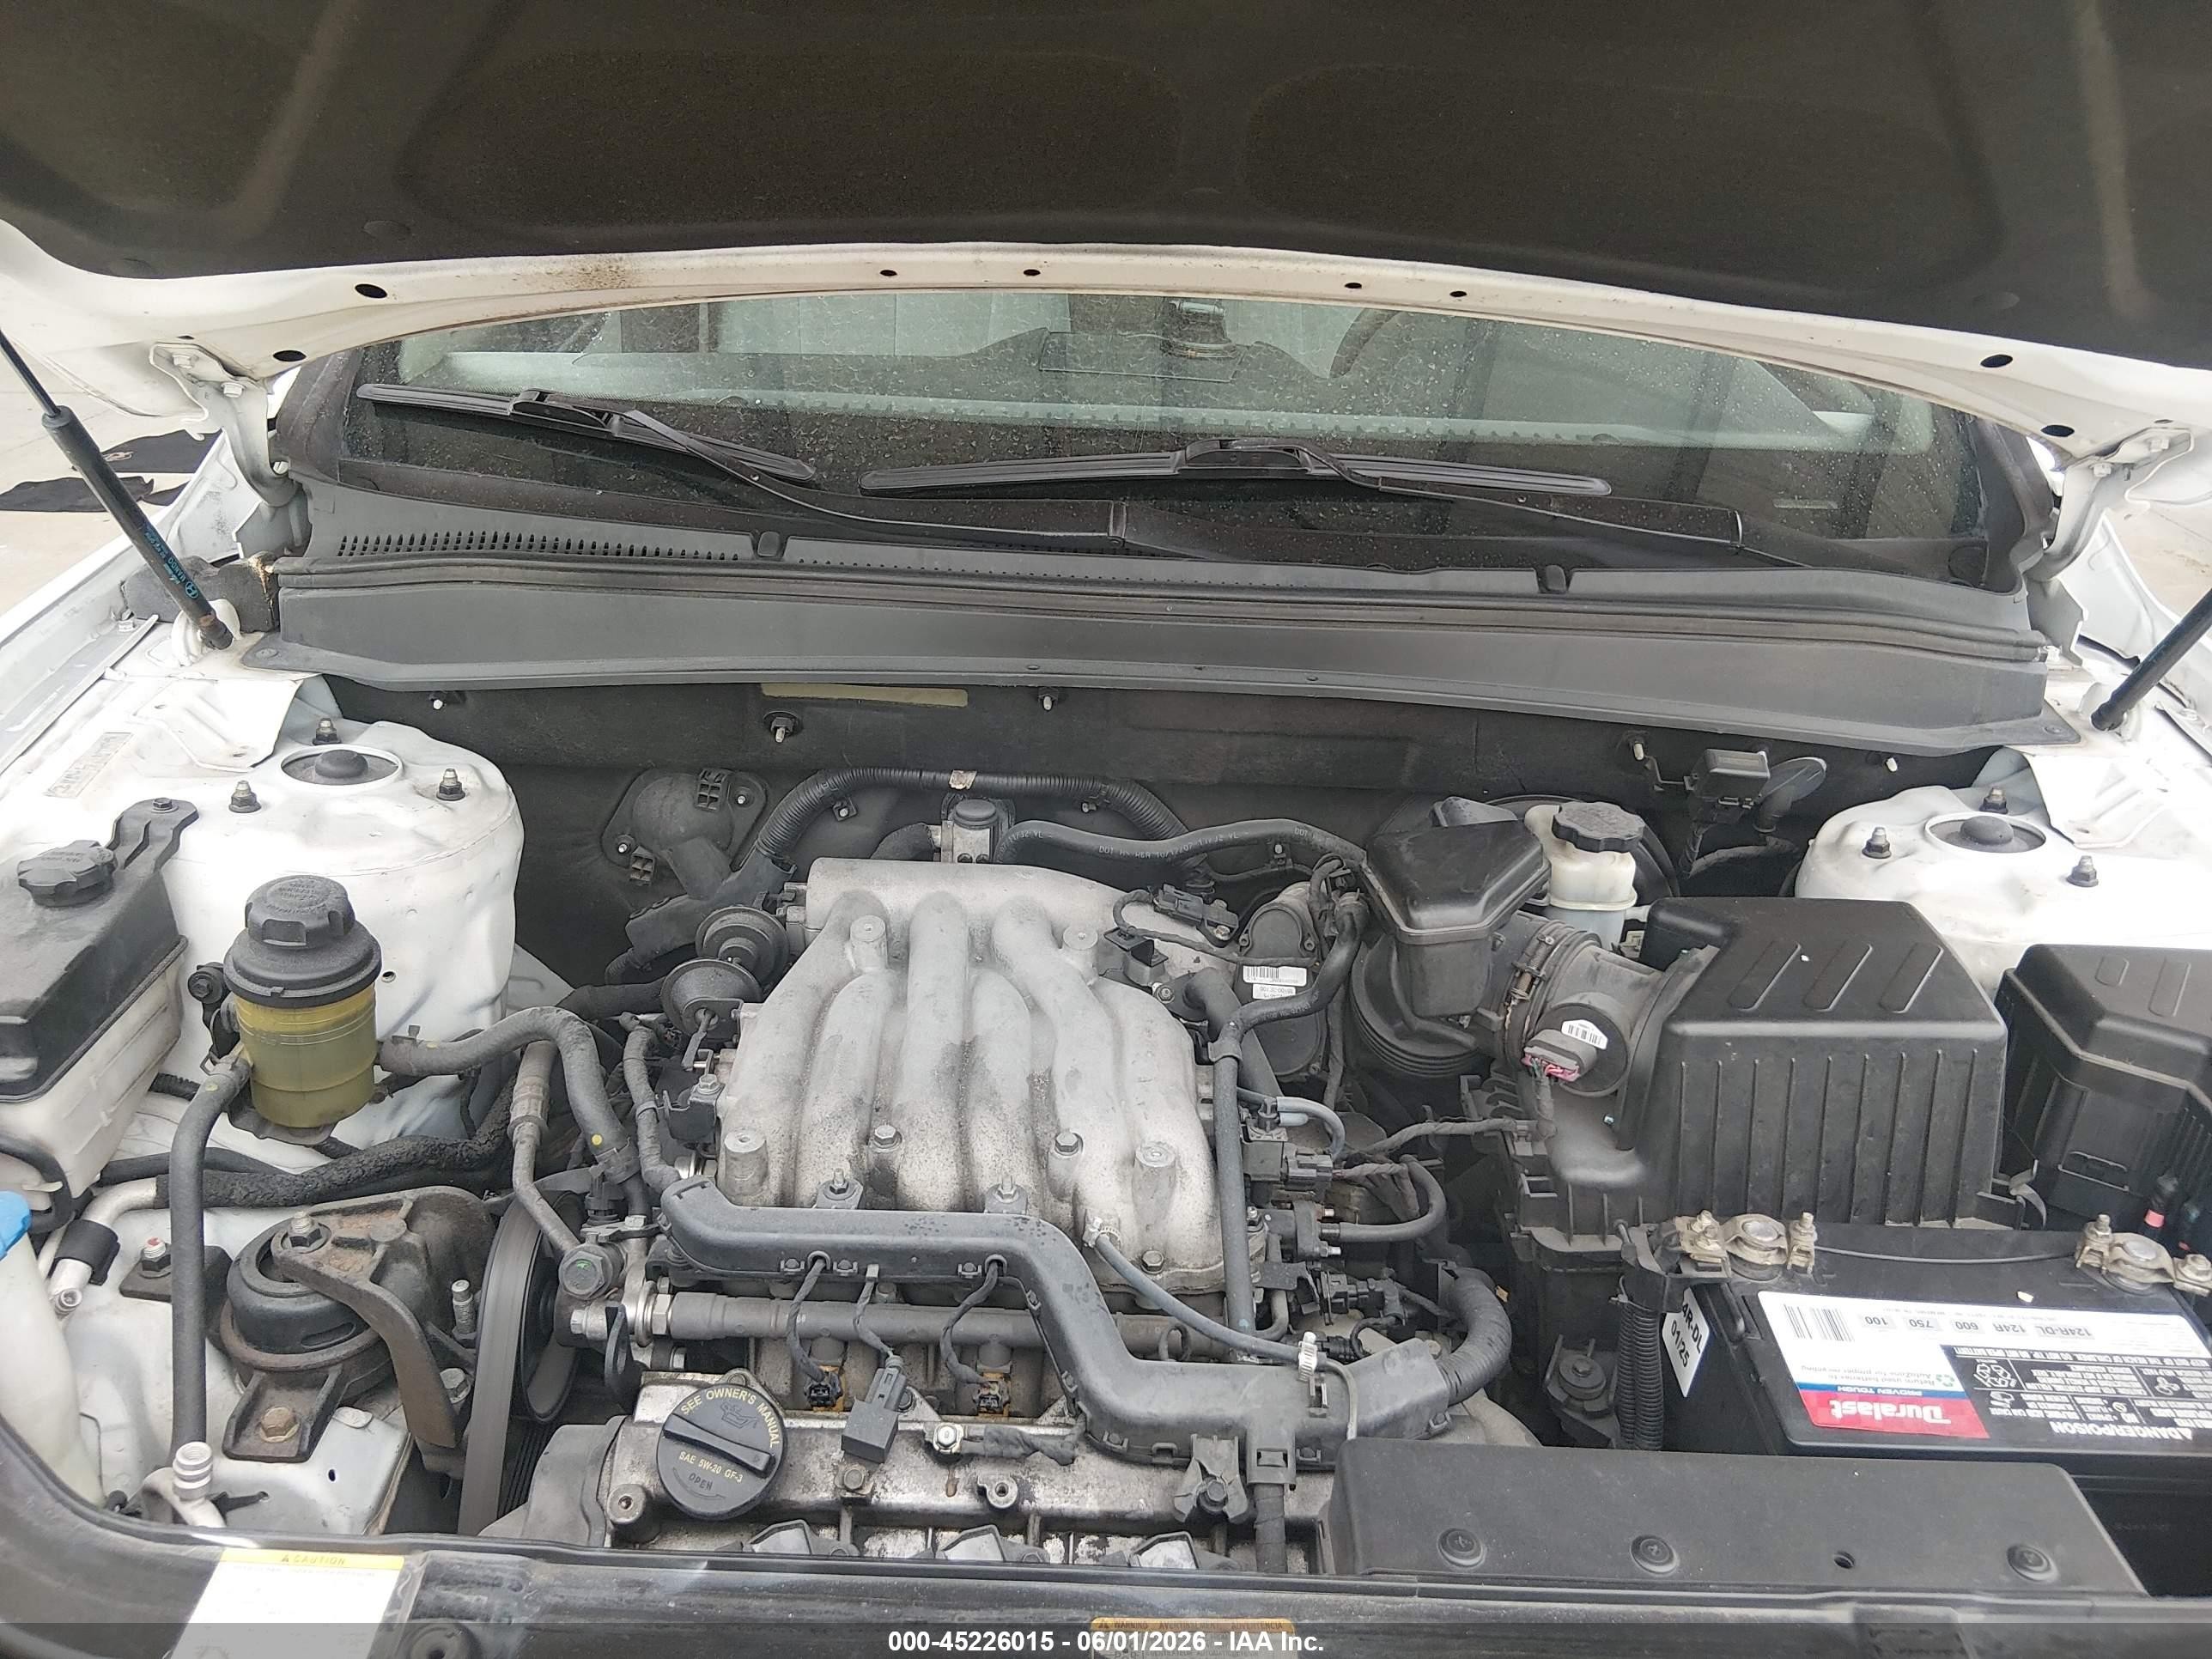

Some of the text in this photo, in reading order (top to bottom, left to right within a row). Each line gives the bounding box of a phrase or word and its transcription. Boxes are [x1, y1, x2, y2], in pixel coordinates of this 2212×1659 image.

[1865, 1316, 2092, 1338] 124R-DL 124R 600 750 100
[1670, 1320, 1691, 1367] 01/25
[1837, 1385, 1923, 1396] PROVEN TOUGH
[681, 1388, 781, 1449] SEE OWNER'S MANUAL
[1829, 1399, 1953, 1425] Duralast
[2049, 1420, 2184, 1441] DANGER/POISON
[678, 1449, 744, 1484] SAE 5W-20 GF-3
[688, 1472, 714, 1492] OPEN
[293, 1555, 345, 1566] CAUTION
